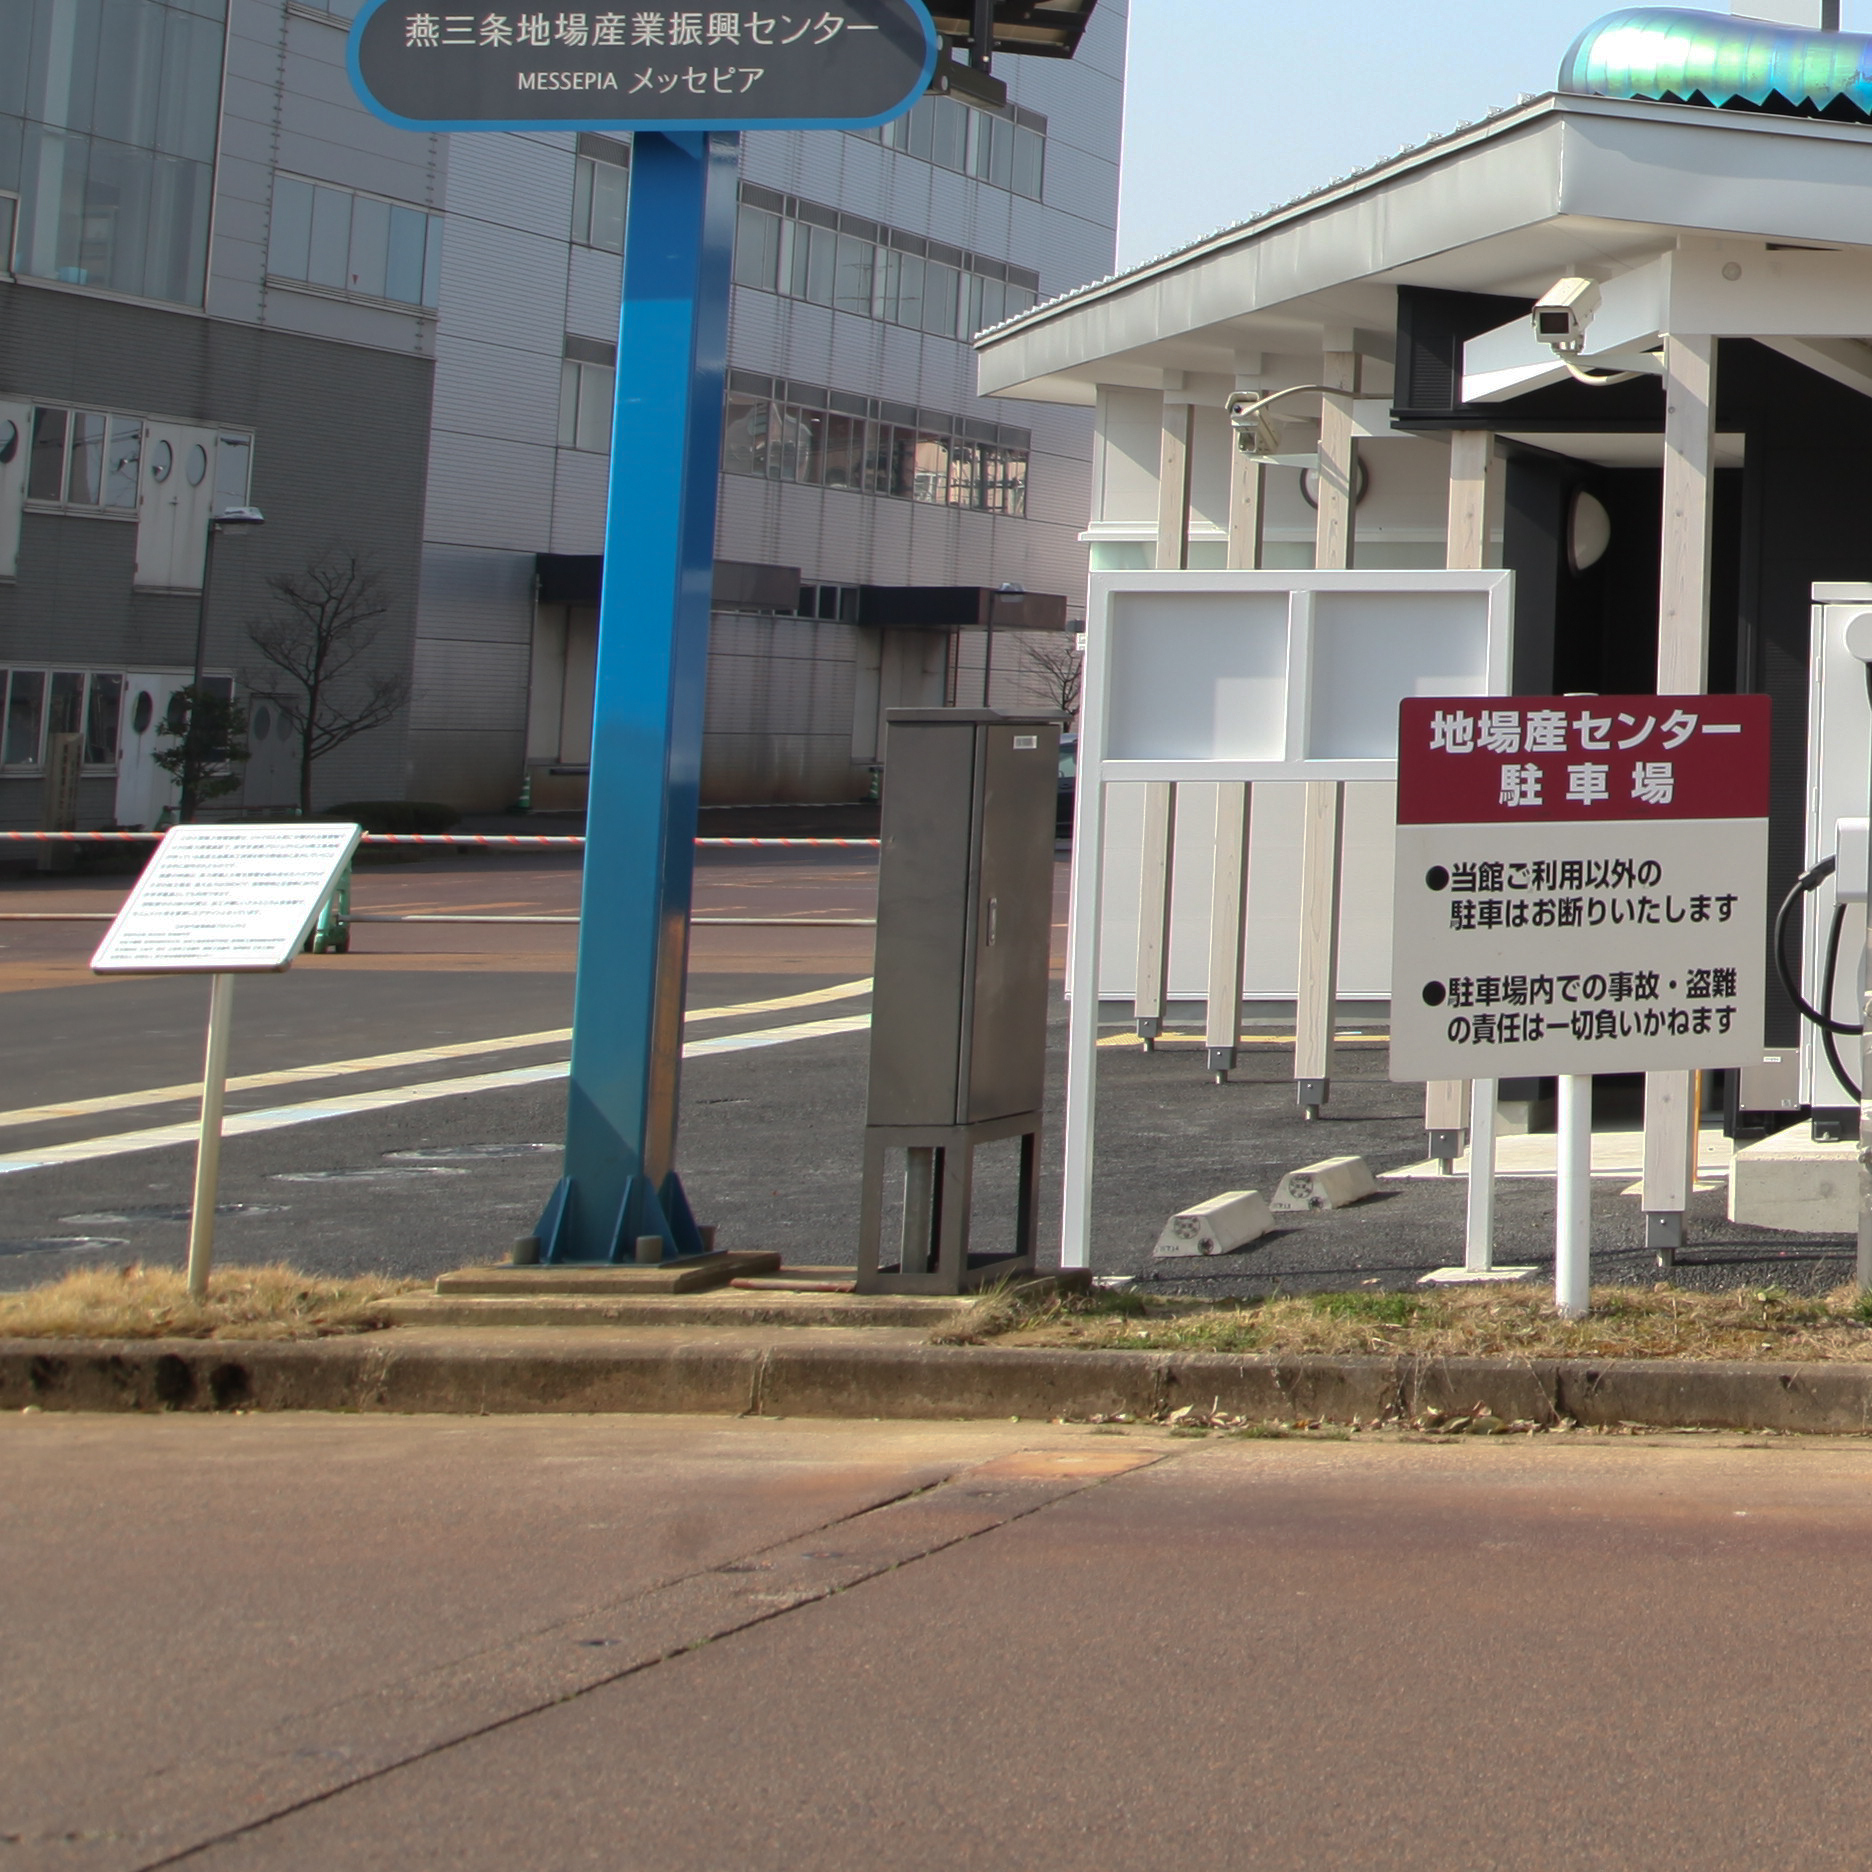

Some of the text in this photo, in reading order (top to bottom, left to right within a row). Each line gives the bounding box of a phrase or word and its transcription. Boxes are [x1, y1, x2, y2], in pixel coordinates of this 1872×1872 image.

[405, 11, 880, 49] 燕三条地場産業振興センター
[518, 66, 766, 96] MESSEPIA メッセピア
[1429, 709, 1742, 755] 地場産センター
[1498, 761, 1676, 807] 駐車場
[1450, 859, 1662, 894] 当館ご利用以外の
[1449, 892, 1739, 932] 駐車はお断りいたします
[1447, 967, 1738, 1008] 駐車場内での事故・盗難
[1447, 1004, 1738, 1046] の責任は一切負いかねます
